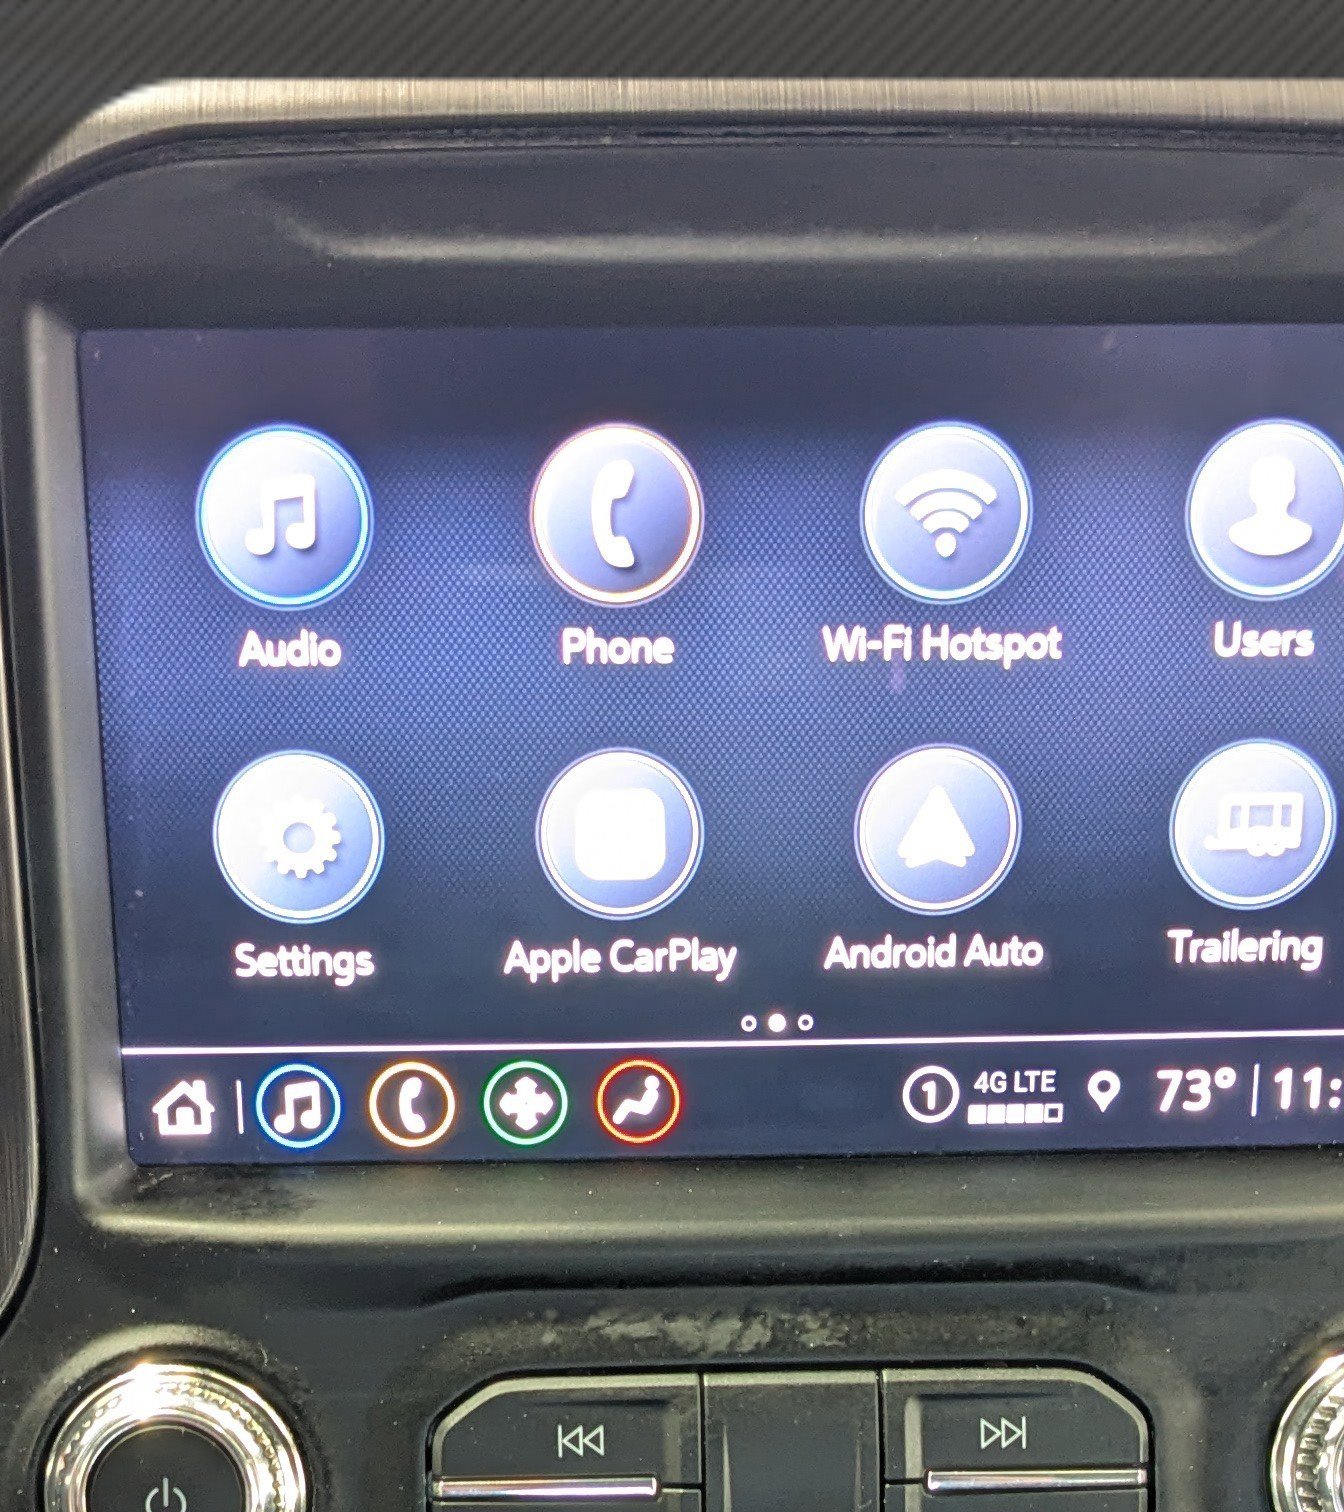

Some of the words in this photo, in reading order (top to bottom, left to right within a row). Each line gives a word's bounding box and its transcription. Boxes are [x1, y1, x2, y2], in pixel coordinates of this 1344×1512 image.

[238, 628, 342, 668] Audio
[562, 626, 675, 665] Phone
[821, 623, 913, 663] Wi-Fi
[922, 624, 1063, 670] Hotspot
[1214, 620, 1315, 658] Users
[234, 942, 375, 987] Settings
[503, 937, 602, 984] Apple
[609, 936, 738, 982] CarPlay
[823, 932, 957, 970] Android
[963, 932, 1044, 968] Auto
[1166, 927, 1324, 972] Trailering
[973, 1070, 1008, 1094] 4G
[1013, 1069, 1057, 1093] LTE
[1156, 1066, 1237, 1113] 73°
